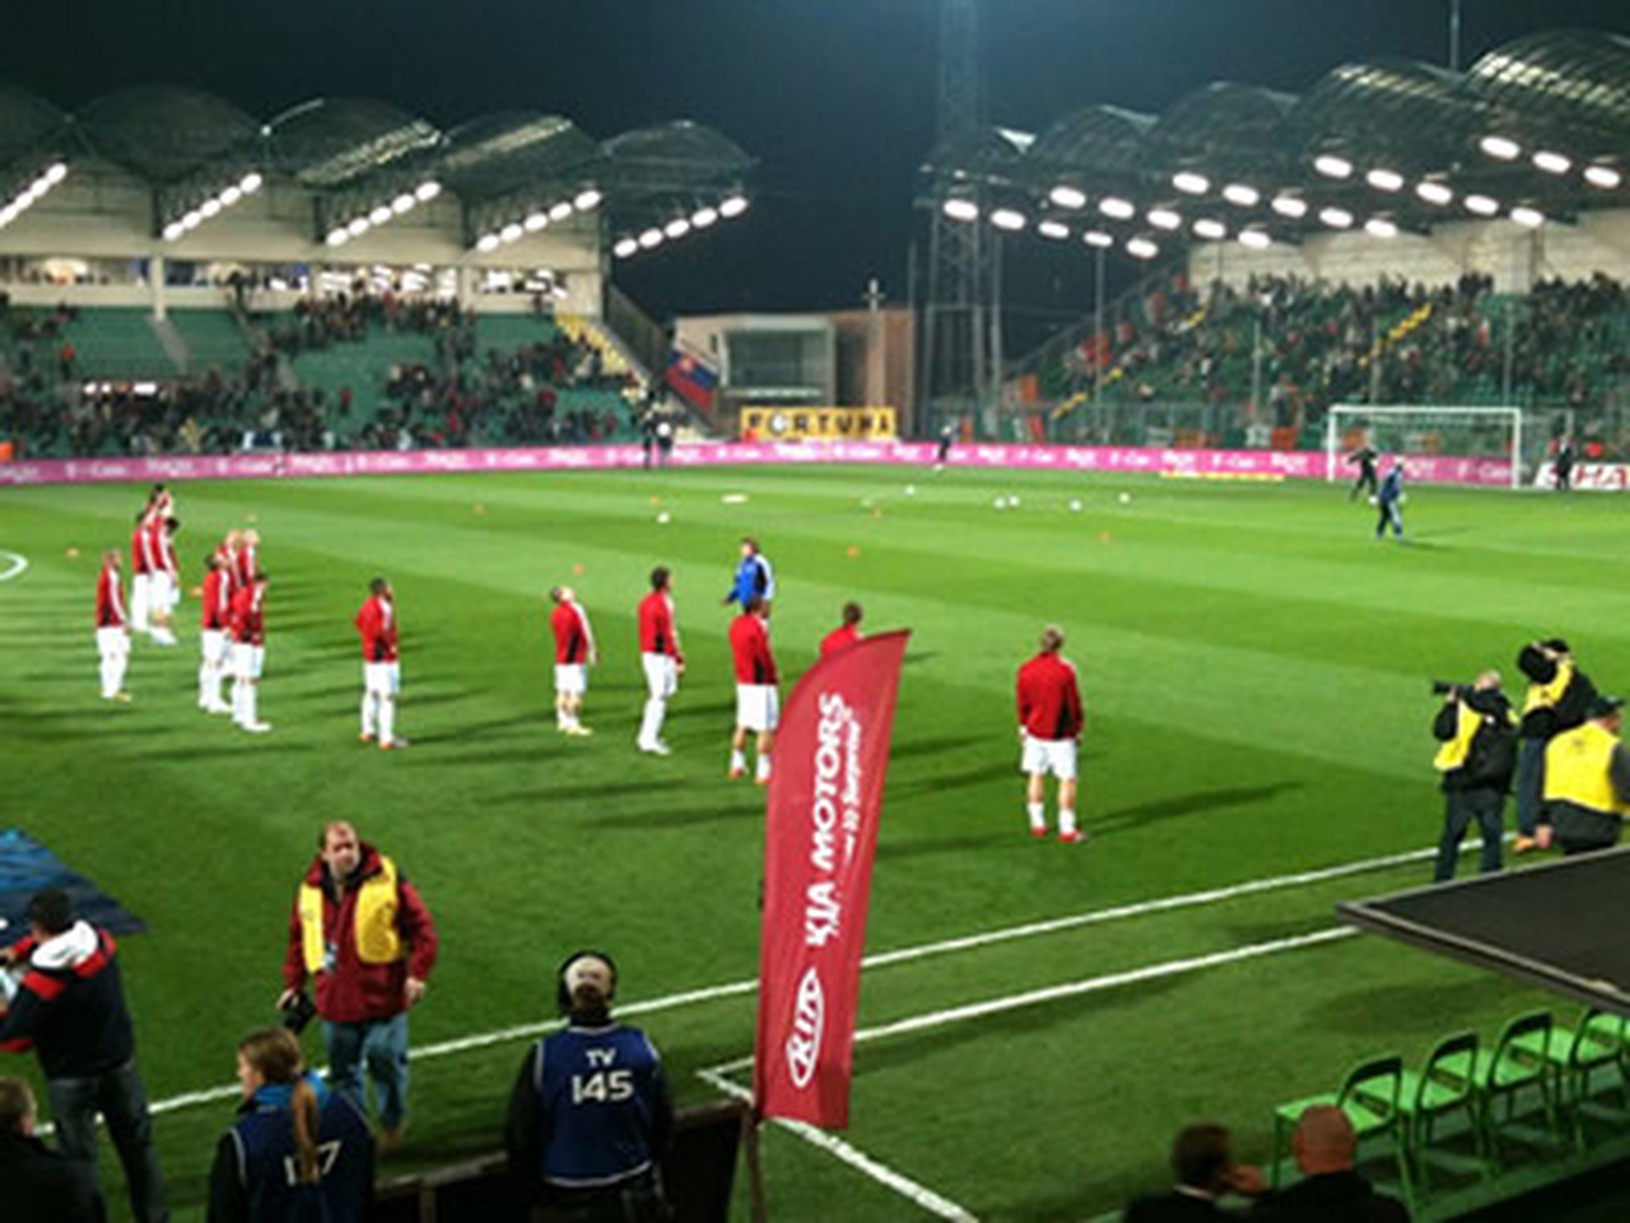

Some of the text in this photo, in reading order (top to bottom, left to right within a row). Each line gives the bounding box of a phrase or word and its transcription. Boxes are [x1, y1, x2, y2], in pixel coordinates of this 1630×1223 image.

[806, 692, 844, 947] KIA MOTORS
[787, 967, 823, 1080] KIA
[586, 1048, 616, 1068] TV
[571, 1070, 634, 1105] 145
[283, 1140, 342, 1187] 17
